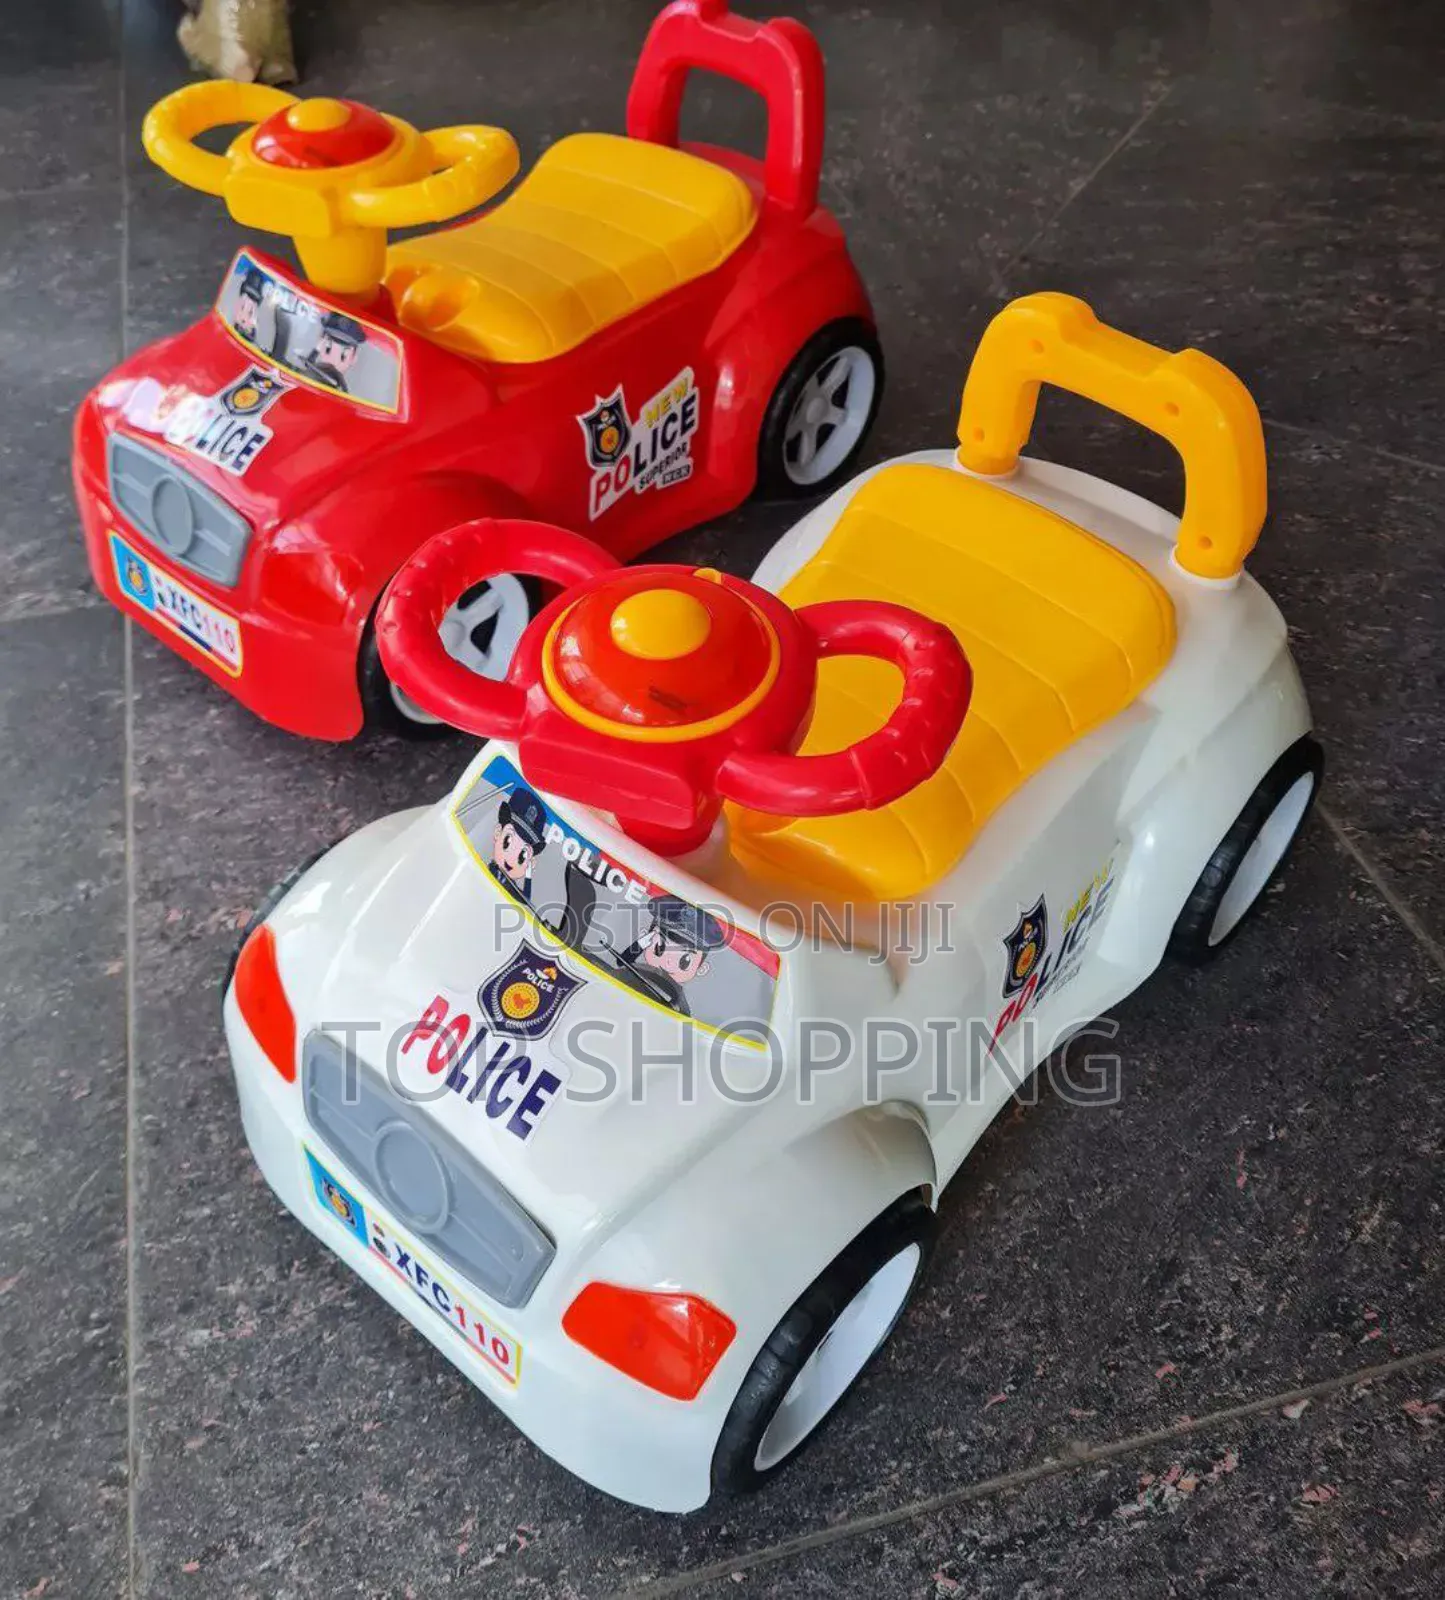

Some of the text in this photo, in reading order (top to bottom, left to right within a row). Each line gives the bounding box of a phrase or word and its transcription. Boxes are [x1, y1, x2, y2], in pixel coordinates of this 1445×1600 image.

[594, 394, 697, 515] POLICE
[645, 378, 689, 429] NEW
[544, 823, 649, 904] POLICE
[521, 966, 556, 993] POLICE
[988, 877, 1115, 1055] POLICE
[400, 994, 563, 1141] POLICE
[394, 1242, 510, 1365] XFC110
